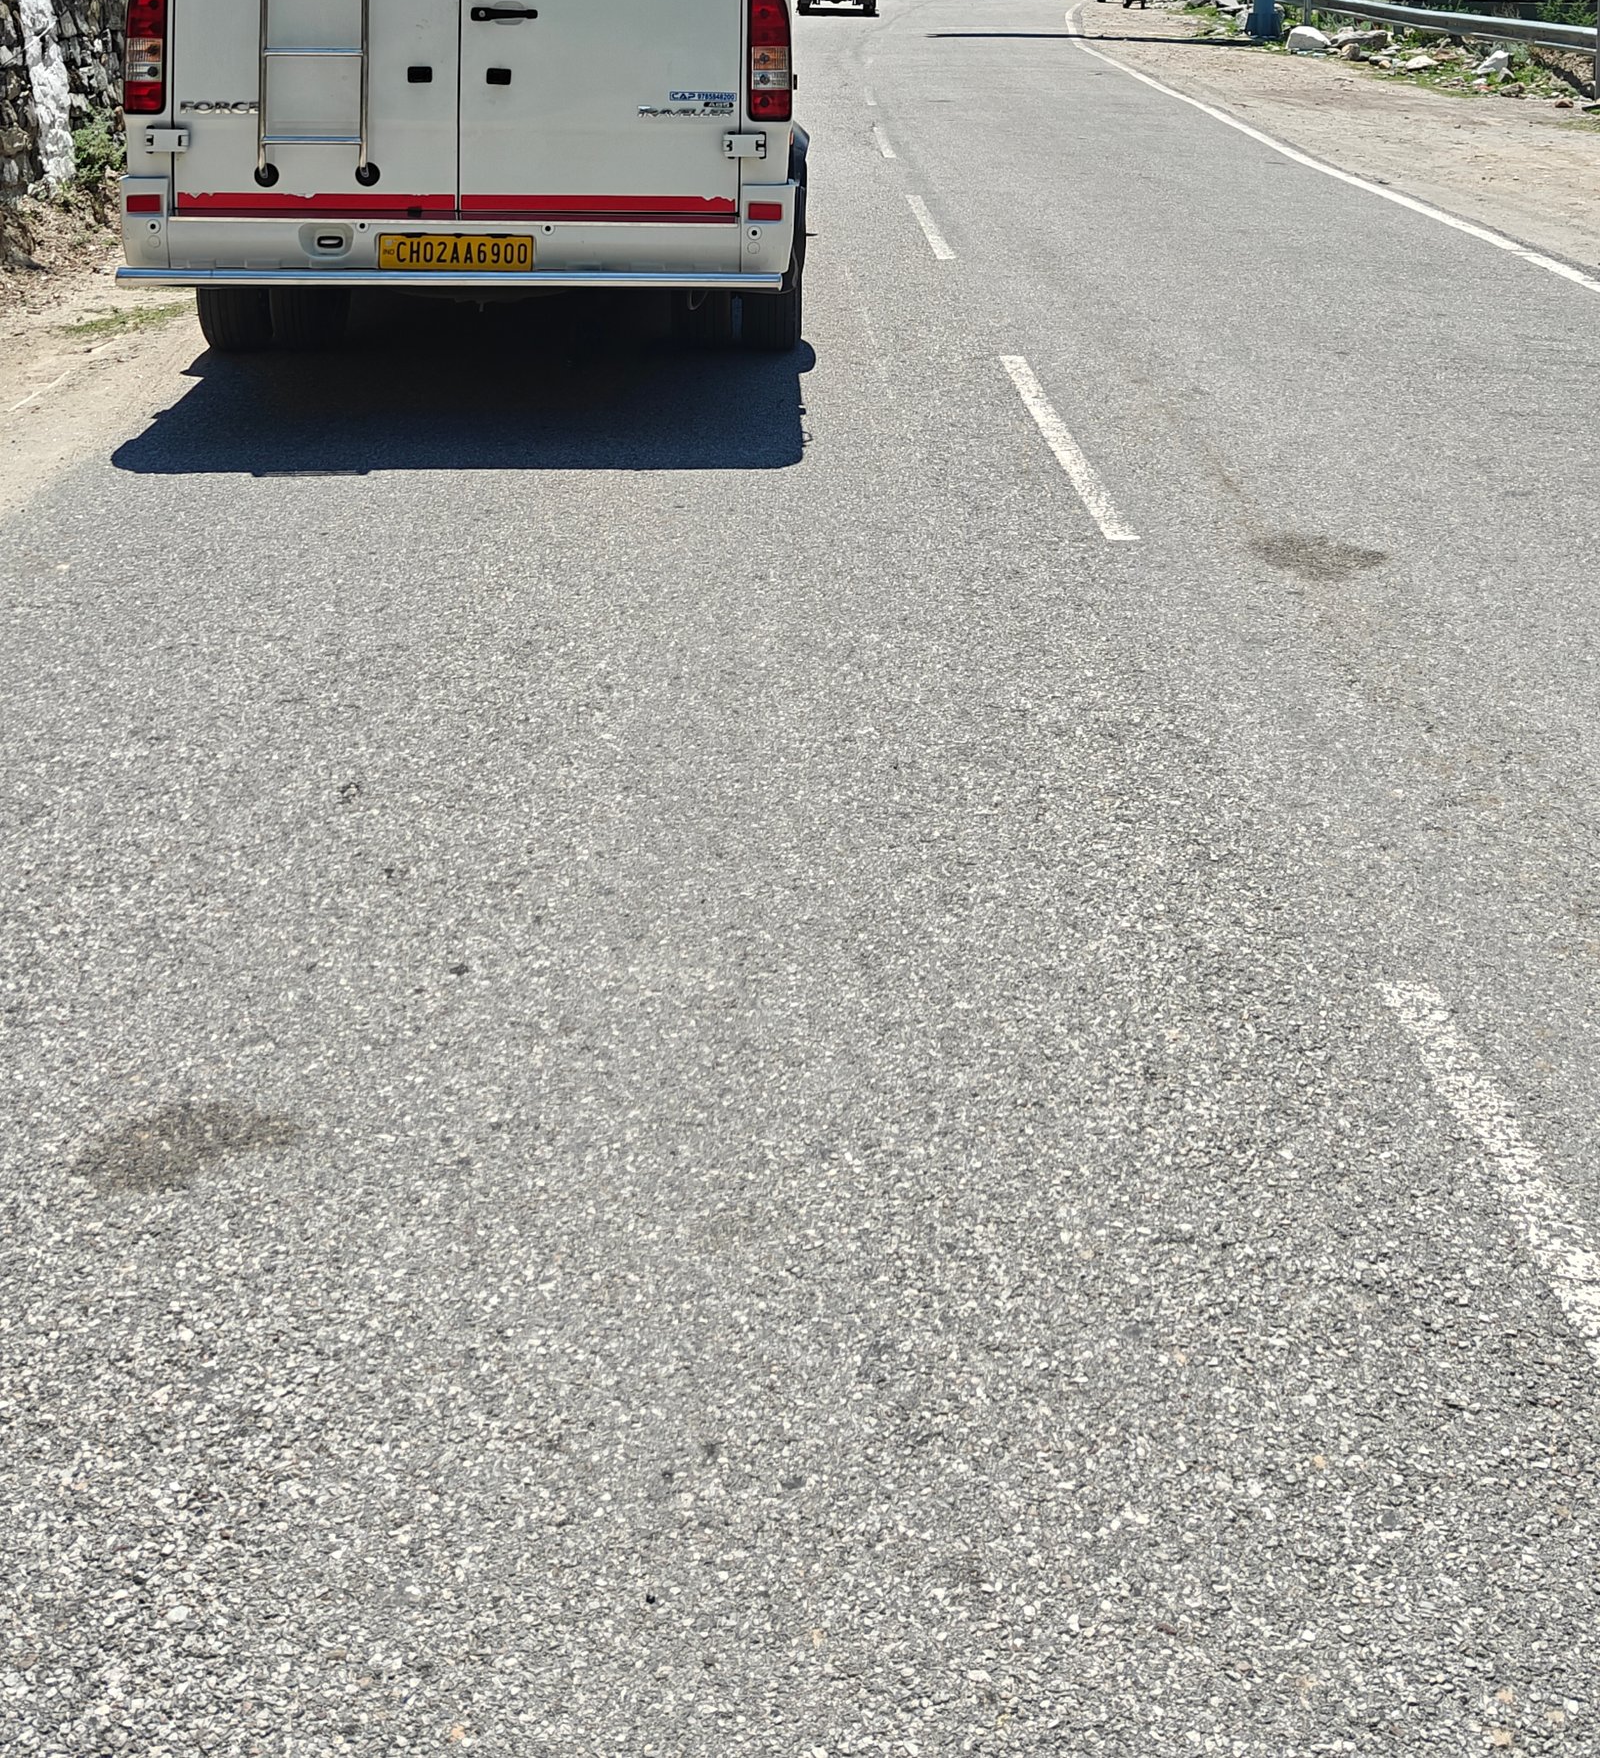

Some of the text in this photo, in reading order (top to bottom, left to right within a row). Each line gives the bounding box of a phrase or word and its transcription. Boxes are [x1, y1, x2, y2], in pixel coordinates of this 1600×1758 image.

[672, 92, 695, 100] CAP
[180, 101, 259, 114] FORCE
[637, 105, 734, 117] TRAVELLER
[396, 241, 528, 264] CH02AA6900
